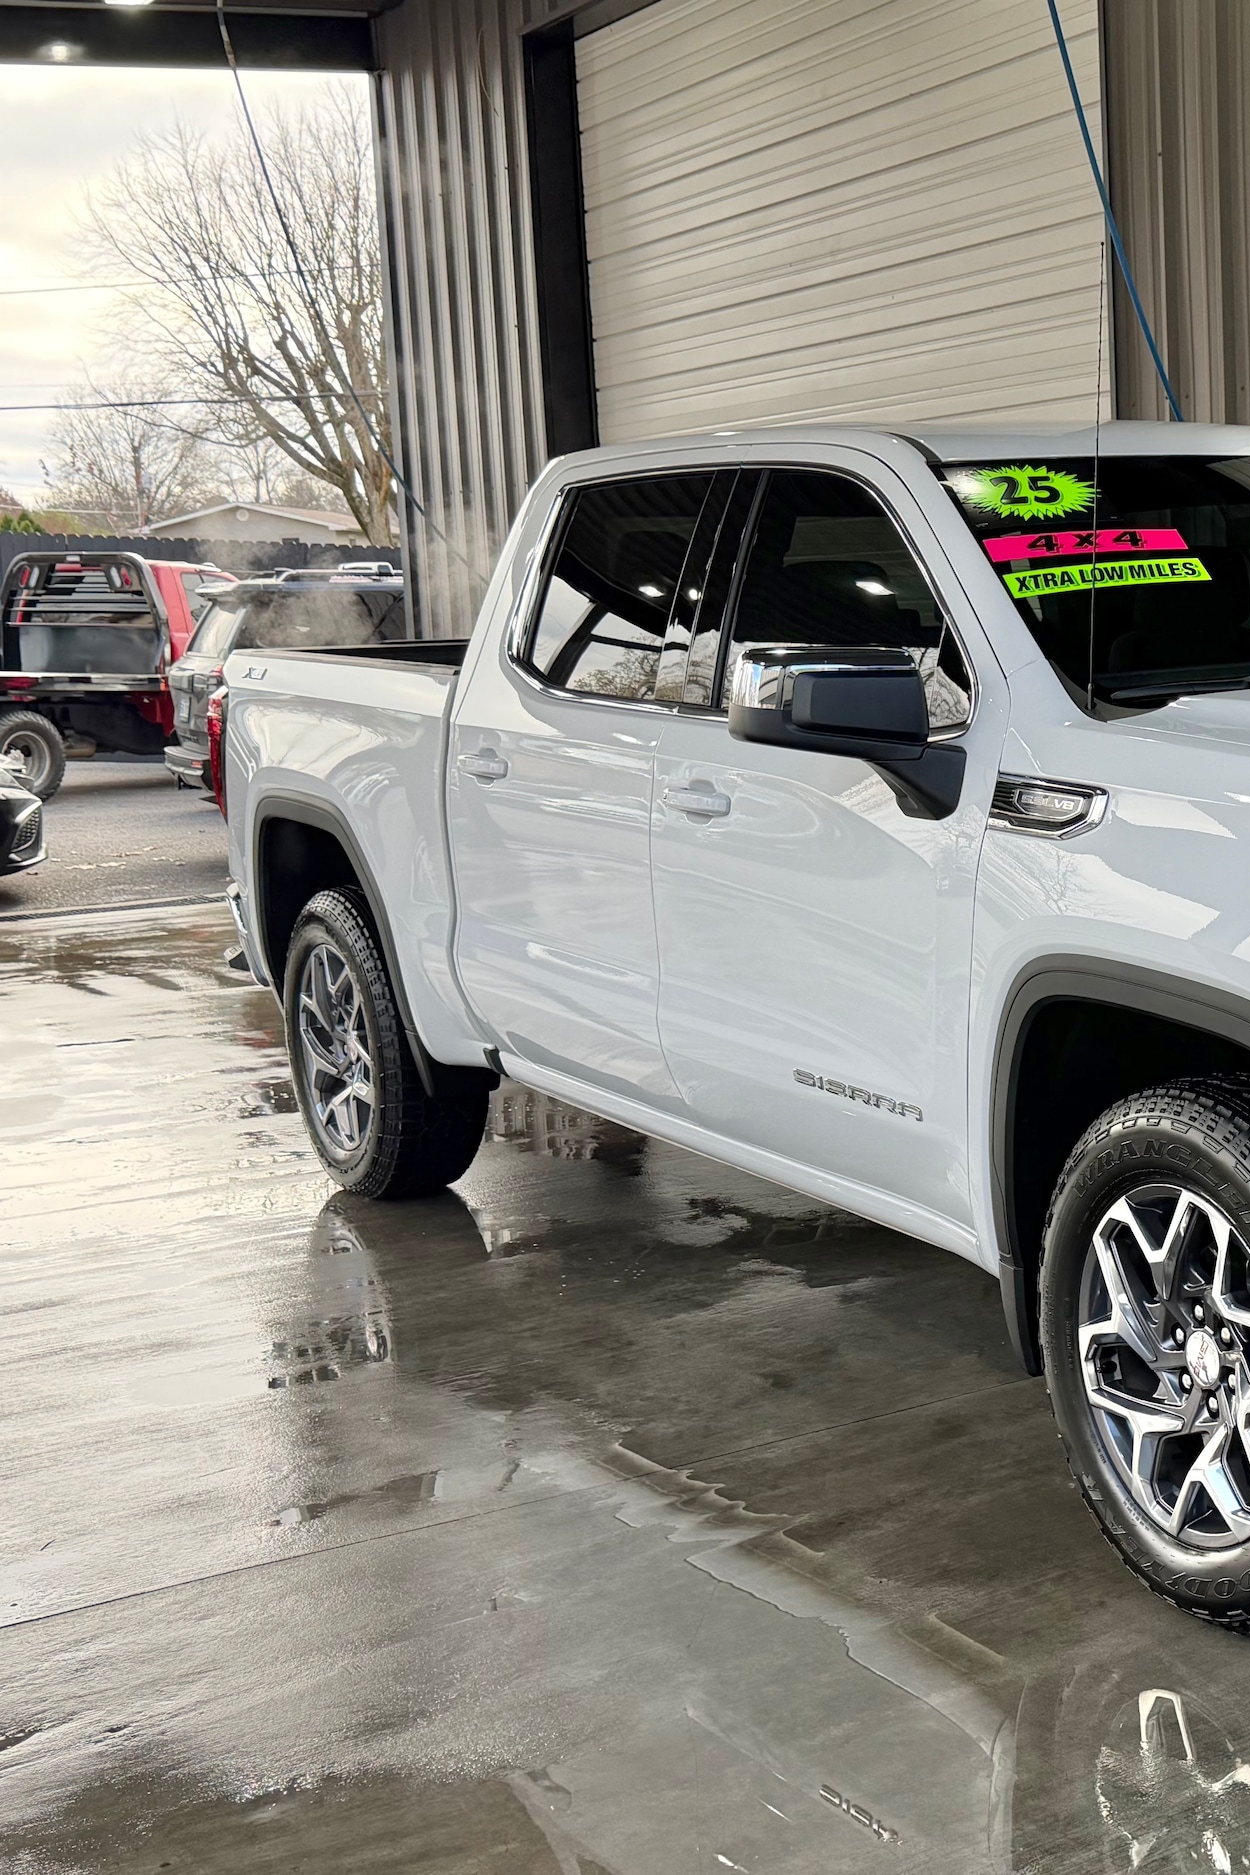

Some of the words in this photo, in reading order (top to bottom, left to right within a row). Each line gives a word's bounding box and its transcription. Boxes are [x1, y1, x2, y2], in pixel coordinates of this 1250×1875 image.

[989, 475, 1062, 504] 25
[1015, 570, 1076, 592] XTRA
[1079, 565, 1125, 582] LOW
[1128, 561, 1199, 579] MILES
[1054, 798, 1075, 811] V8
[792, 1068, 923, 1122] SIERRA
